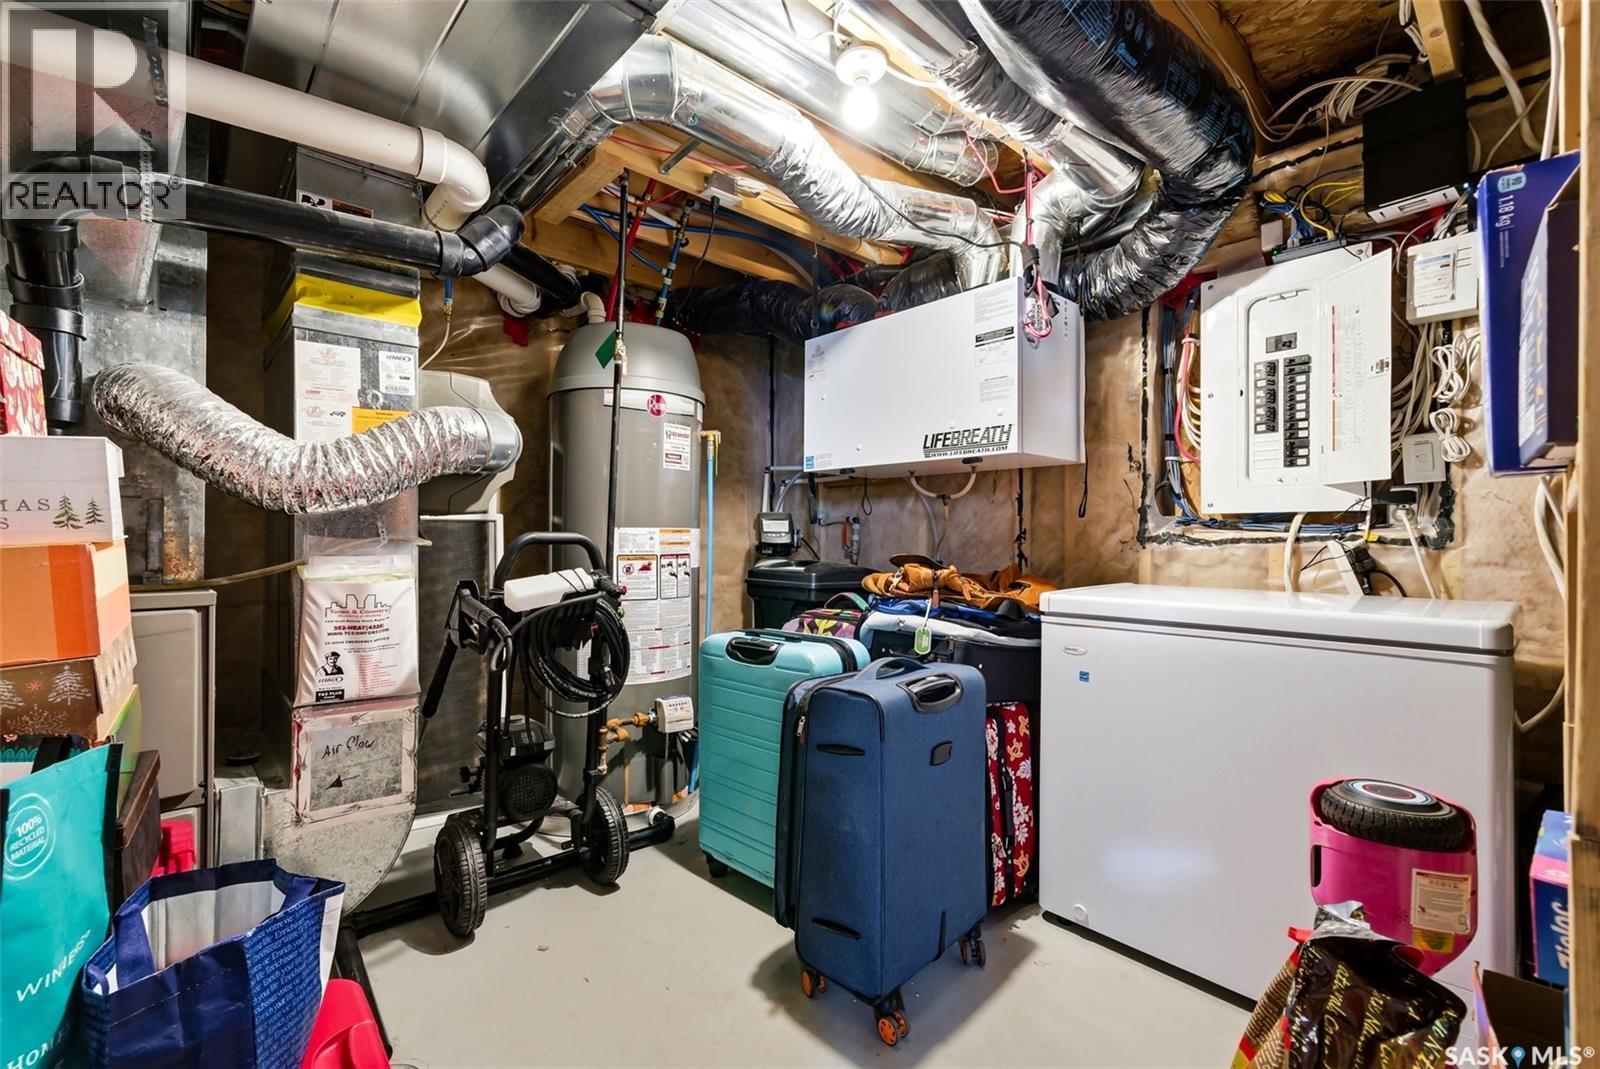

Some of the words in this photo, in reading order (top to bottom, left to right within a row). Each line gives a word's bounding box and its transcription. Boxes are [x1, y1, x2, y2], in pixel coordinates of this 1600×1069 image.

[922, 423, 1012, 450] LIFEBREATH
[9, 825, 46, 852] RECYCLED
[15, 814, 43, 838] 100%
[10, 836, 47, 862] MATERIAL
